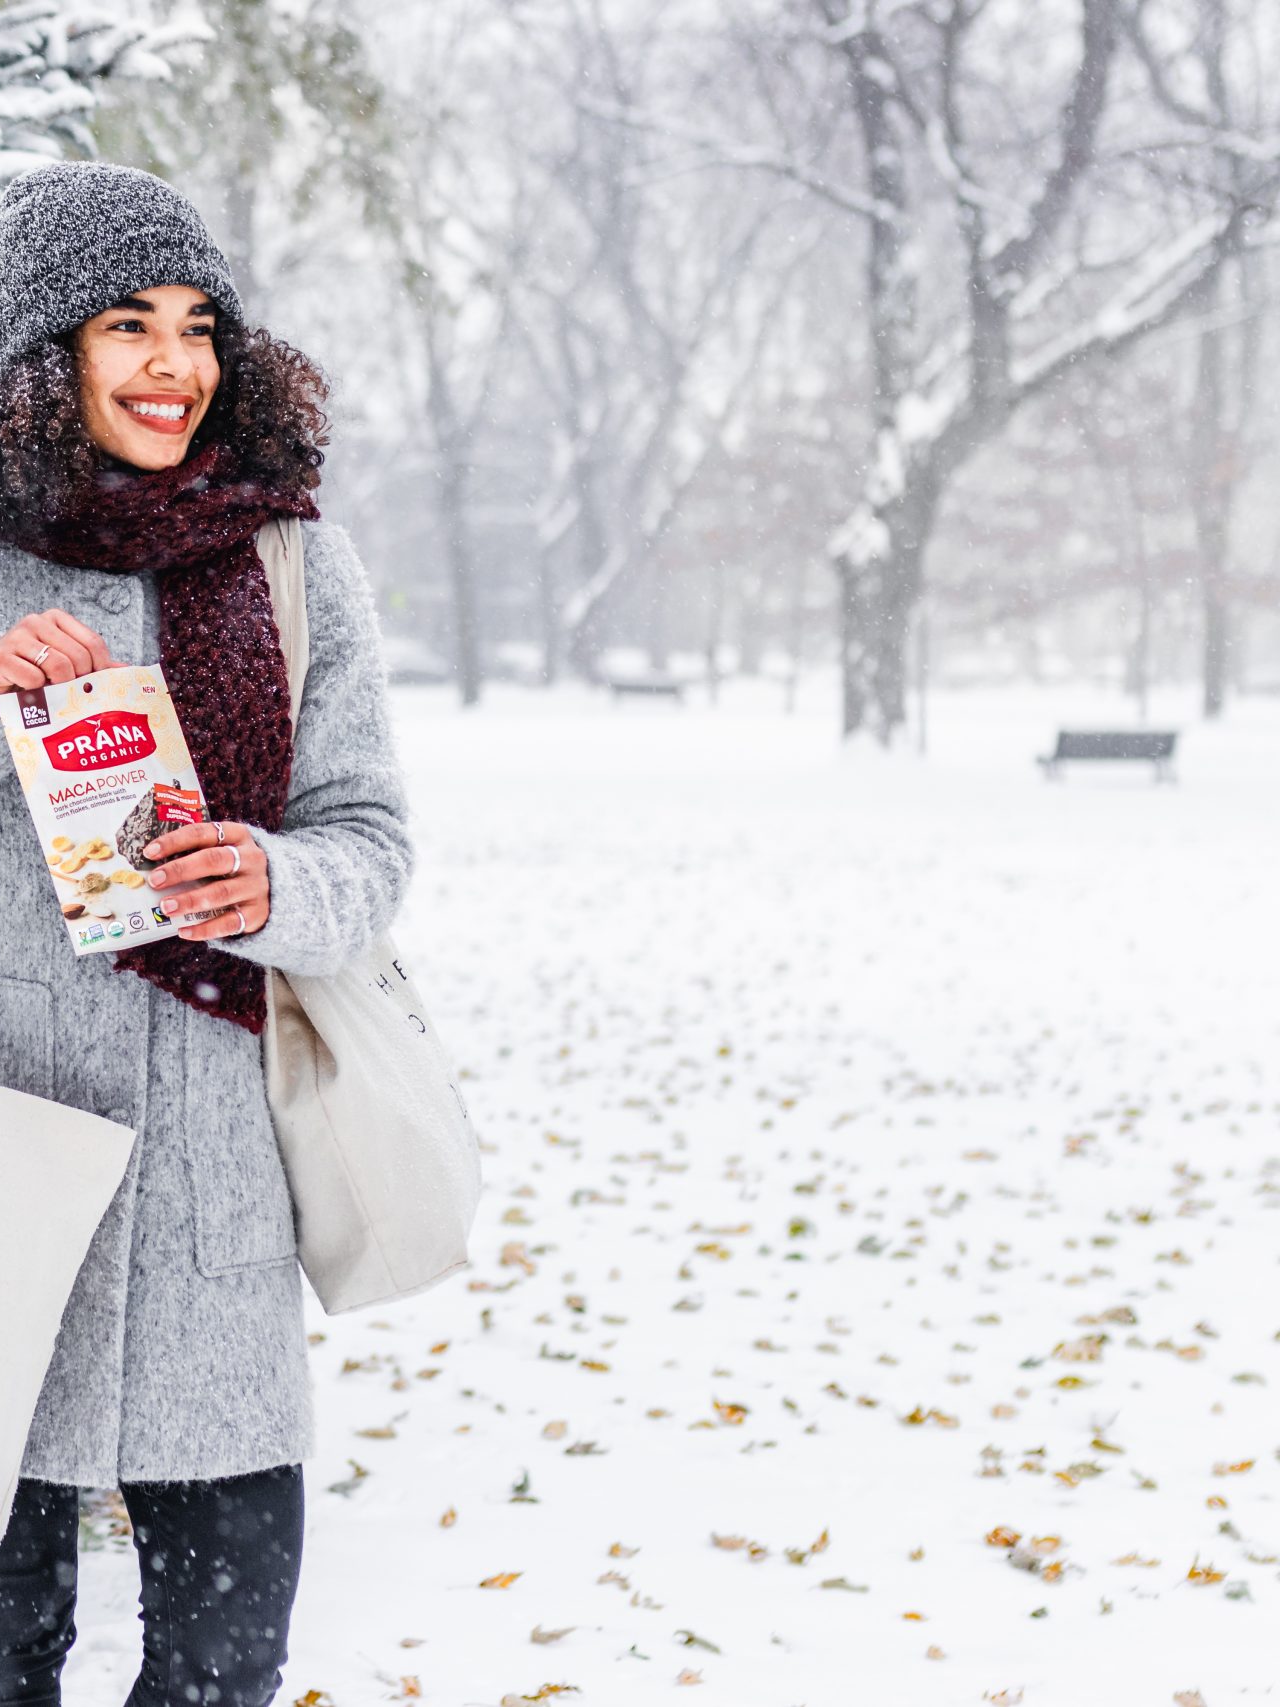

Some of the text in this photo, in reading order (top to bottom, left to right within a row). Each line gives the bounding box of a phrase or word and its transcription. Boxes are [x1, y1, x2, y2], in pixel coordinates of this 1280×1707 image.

[142, 686, 156, 694] NEW
[23, 706, 47, 720] 62%
[26, 716, 48, 726] cacao
[80, 745, 141, 767] ORGANIC
[48, 769, 148, 806] MACA POWER
[53, 787, 127, 813] Dark chocolate bark with
[55, 811, 70, 820] corn
[90, 797, 116, 809] almonds
[120, 793, 137, 801] maca
